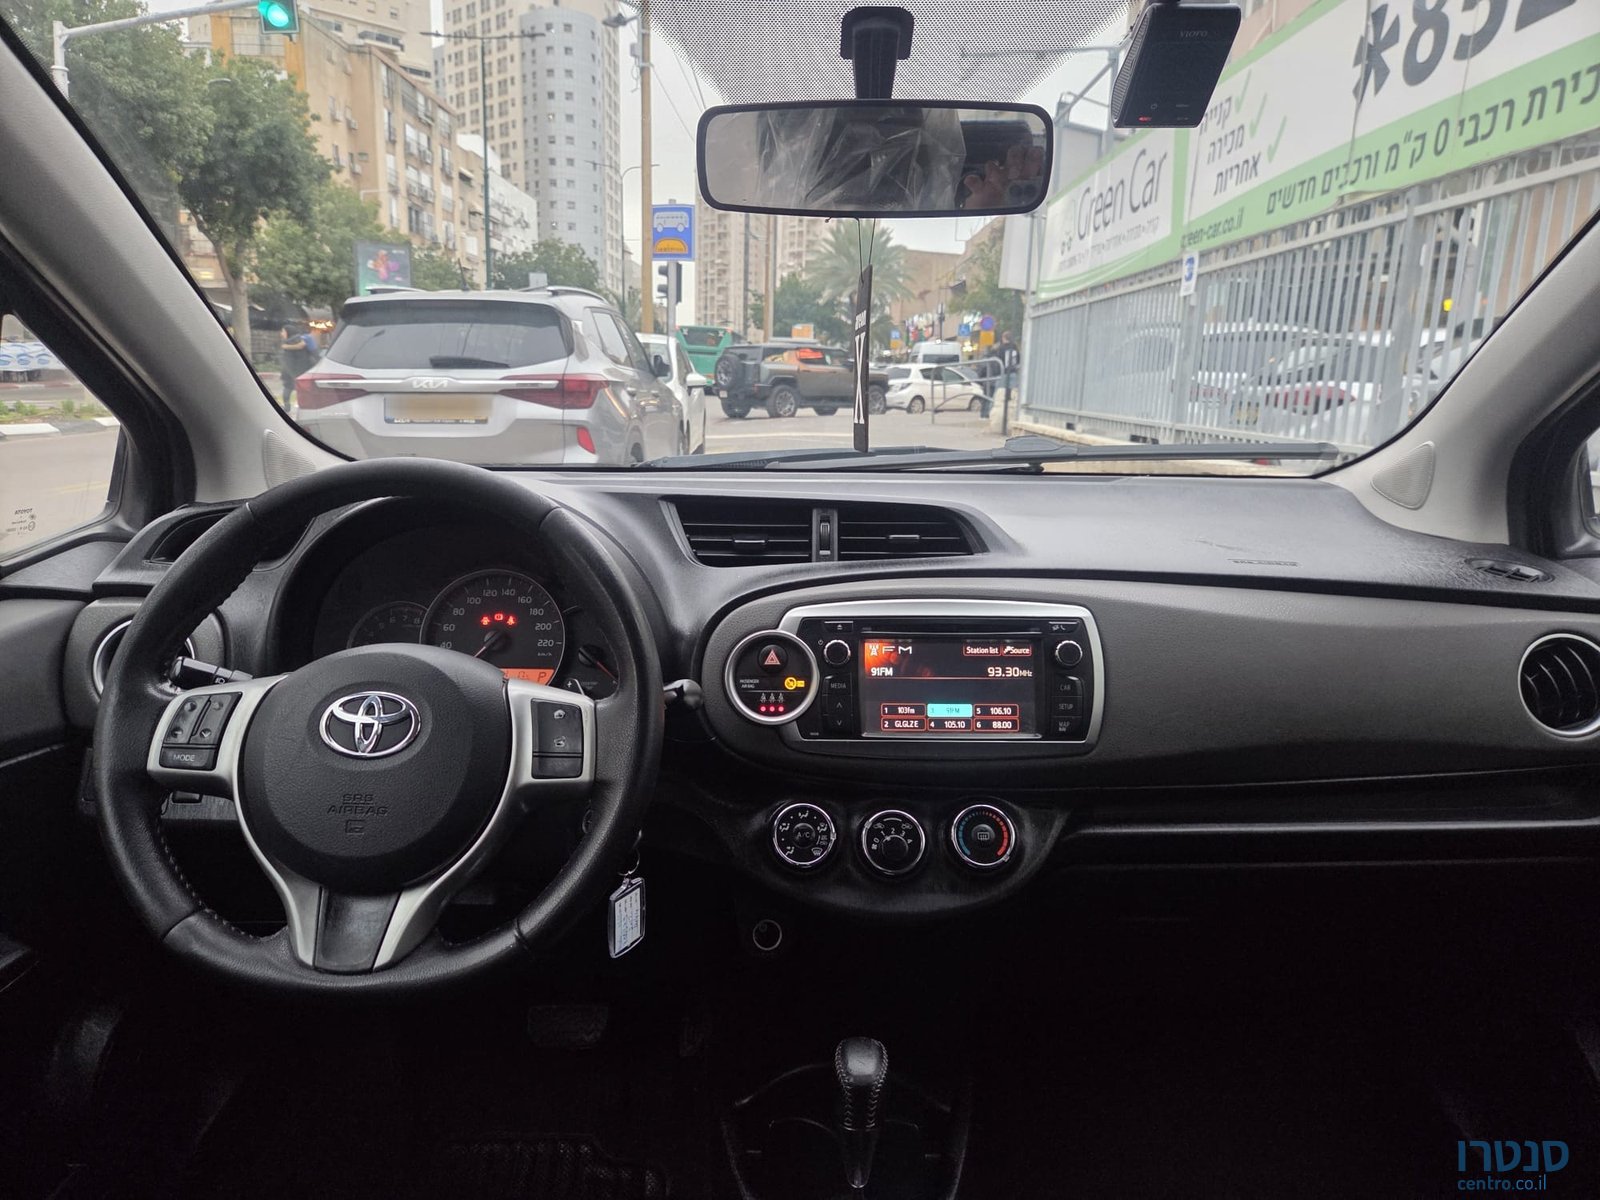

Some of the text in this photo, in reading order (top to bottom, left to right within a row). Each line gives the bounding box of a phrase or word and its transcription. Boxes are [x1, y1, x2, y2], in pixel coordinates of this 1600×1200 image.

[1458, 98, 1515, 148] רכבי
[1433, 118, 1450, 157] 0
[1207, 124, 1245, 165] מכירה
[1213, 151, 1262, 197] אחריות
[1320, 149, 1380, 197] ורכבים
[1077, 148, 1168, 241] Green Car
[1266, 175, 1317, 215] חדשים
[482, 589, 498, 597] 120
[501, 588, 516, 596] 140
[517, 596, 532, 604] 160
[452, 608, 465, 616] 80
[529, 608, 544, 616] 180
[443, 624, 456, 632] 60
[535, 623, 552, 631] 200
[441, 641, 453, 650] 40
[882, 645, 913, 655] FM
[966, 645, 999, 655] Station list
[1010, 646, 1030, 655] Source
[538, 671, 548, 682] P
[870, 667, 893, 677] 91FM
[897, 706, 915, 714] 103fm
[976, 707, 1012, 715] 5 106.10
[944, 720, 966, 729] 105.10
[976, 720, 1012, 729] 6 88.00
[173, 754, 196, 762] MODE
[796, 831, 811, 839] A/C
[890, 827, 896, 835] 2
